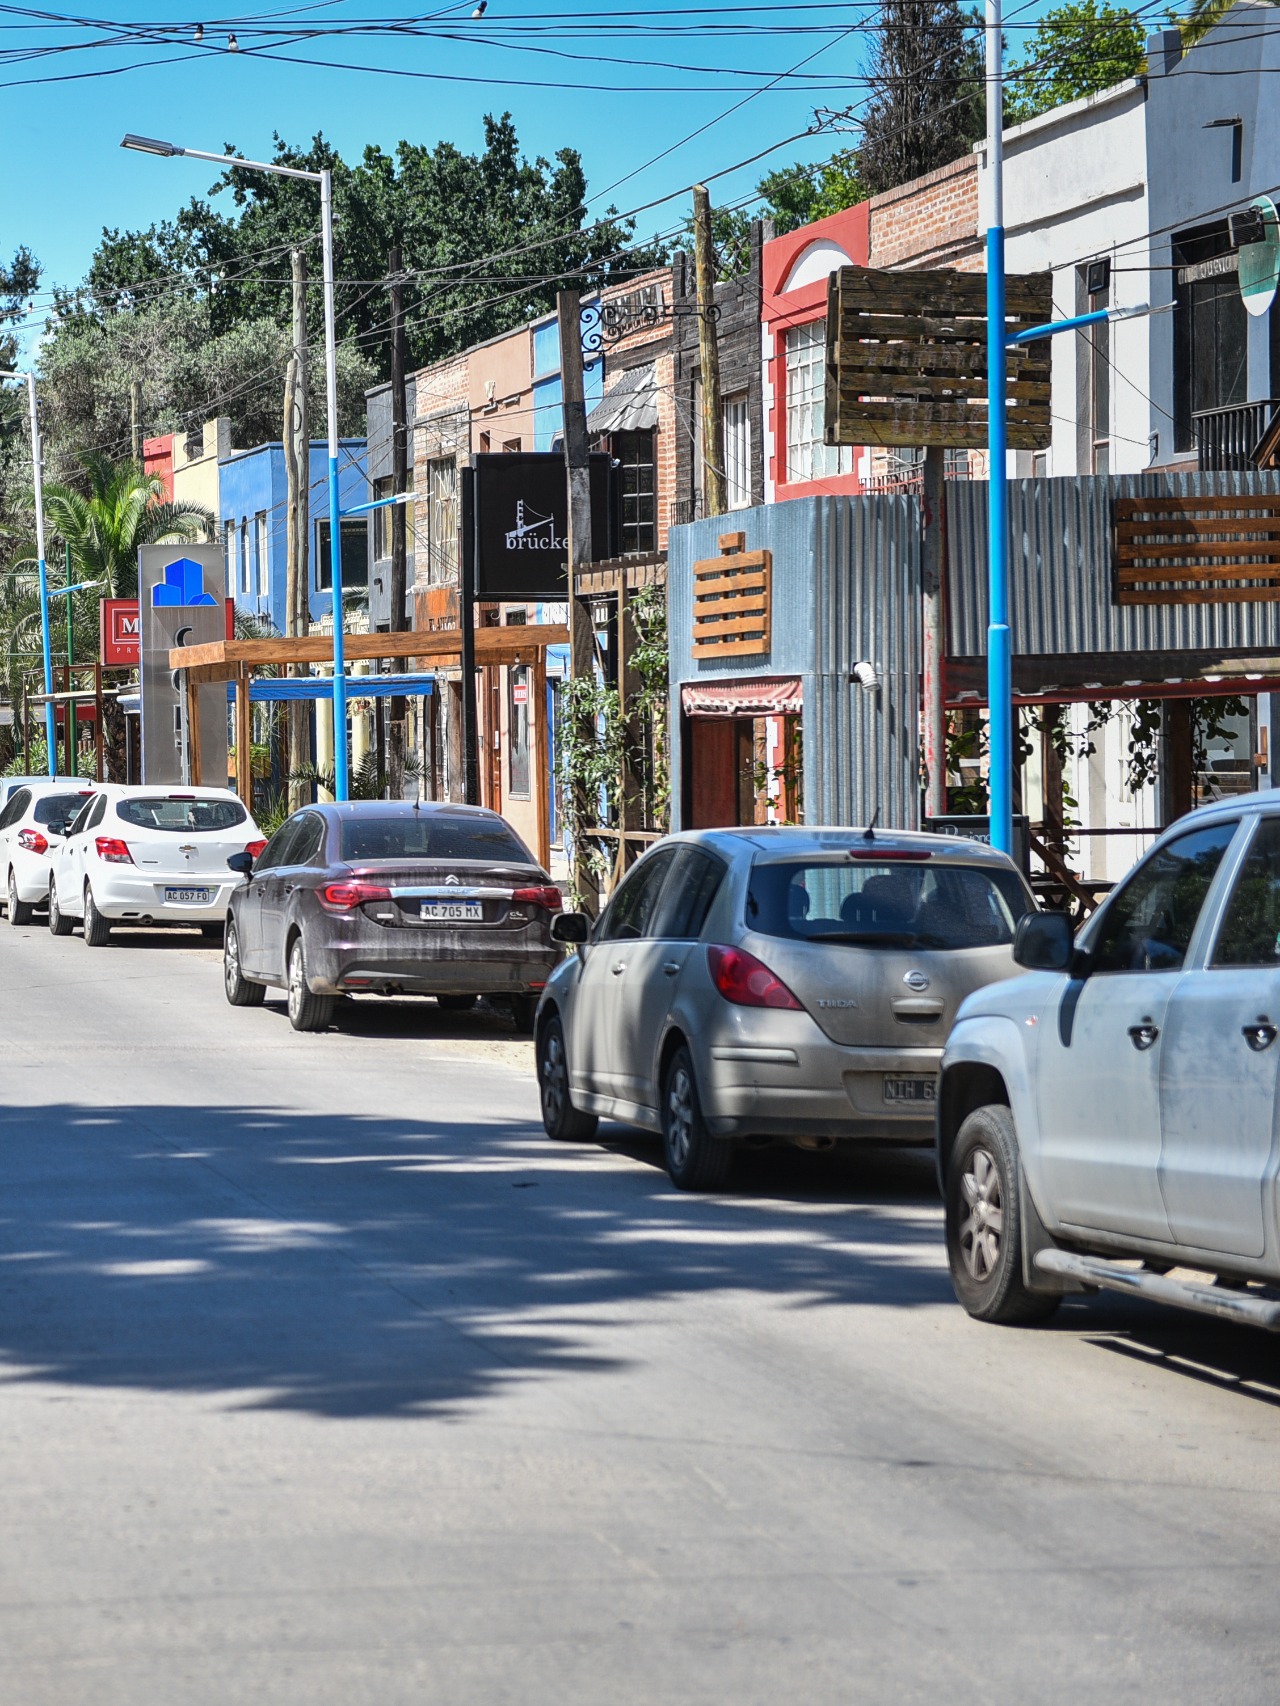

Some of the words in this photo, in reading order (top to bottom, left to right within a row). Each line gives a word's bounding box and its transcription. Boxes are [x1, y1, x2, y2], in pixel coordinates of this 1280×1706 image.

[122, 617, 139, 634] M
[168, 891, 178, 901] AC
[180, 891, 195, 901] 057
[425, 905, 438, 917] AC
[442, 905, 462, 918] 705
[466, 905, 480, 918] MX
[886, 1081, 915, 1099] NIH
